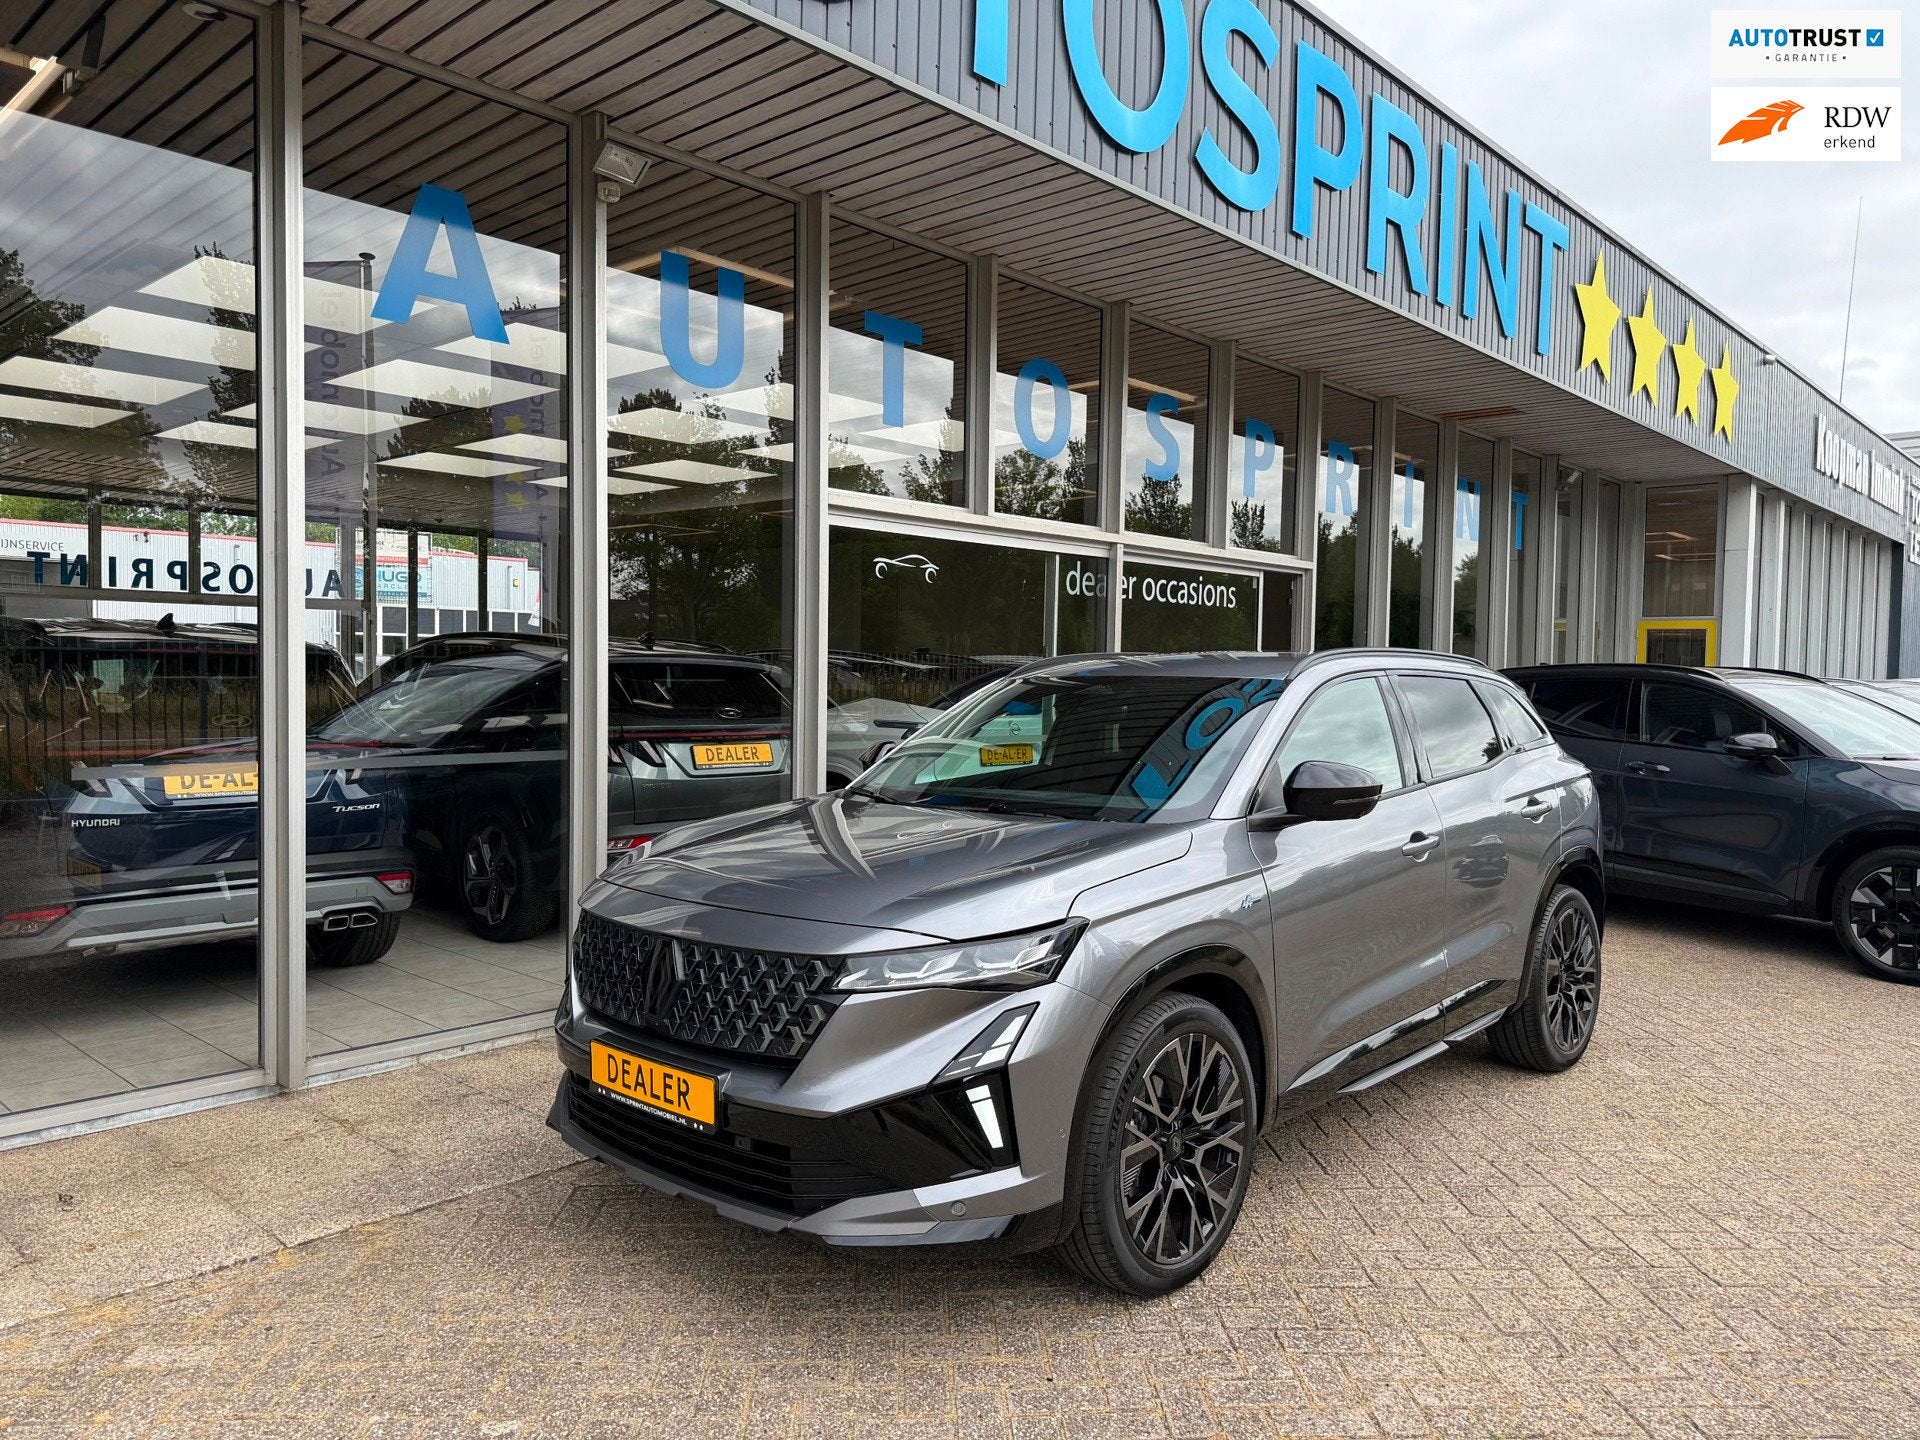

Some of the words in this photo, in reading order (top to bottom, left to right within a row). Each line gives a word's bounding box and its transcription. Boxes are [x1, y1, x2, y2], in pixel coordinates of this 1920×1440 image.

[1065, 560, 1137, 599] deaer
[1142, 576, 1237, 609] occasions
[705, 746, 760, 762] DEALER
[71, 818, 120, 828] HYUNDAI
[607, 1053, 691, 1111] DEALER
